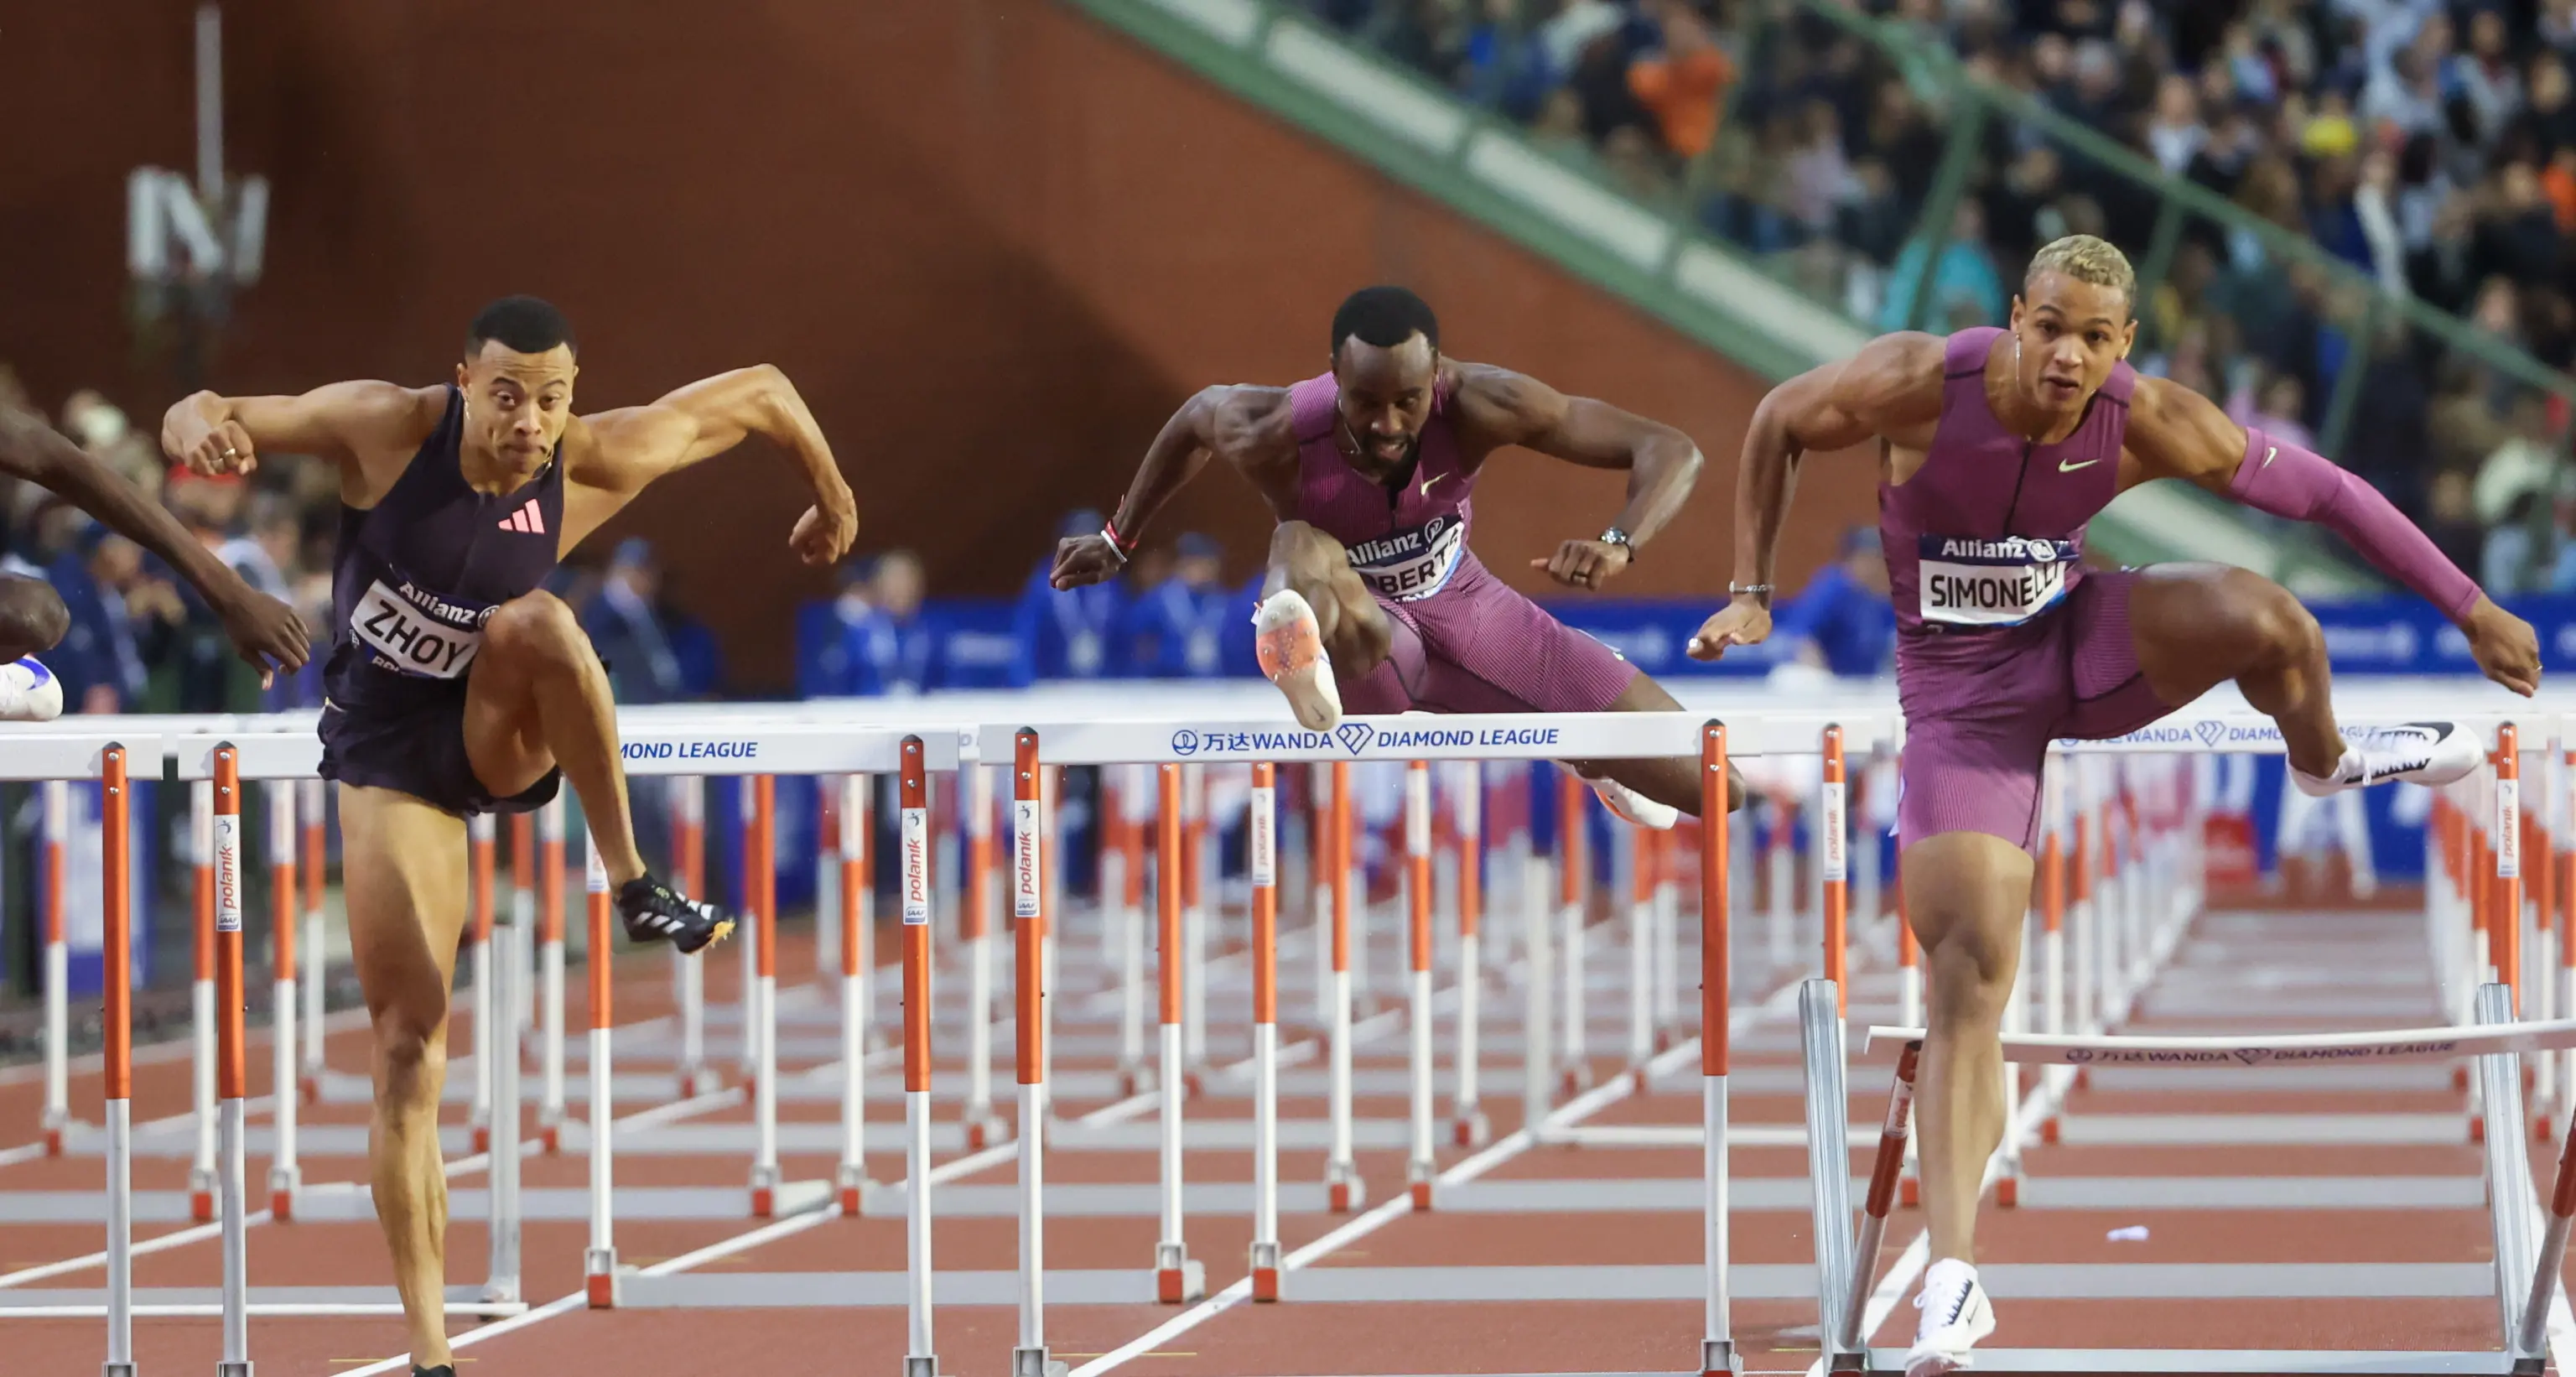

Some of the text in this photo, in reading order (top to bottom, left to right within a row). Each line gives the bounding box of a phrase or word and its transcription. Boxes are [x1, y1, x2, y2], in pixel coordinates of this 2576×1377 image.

[1346, 531, 1422, 565] Allianz
[1941, 538, 2027, 559] Allianz
[398, 581, 477, 625] Allianz
[1930, 563, 2059, 608] SIMONELLI
[678, 742, 758, 758] LEAGUE
[1377, 730, 1474, 747] DIAMOND
[1479, 729, 1560, 746] LEAGUE
[218, 844, 238, 910] polanik
[906, 837, 924, 902] polanik
[1018, 830, 1035, 896] polanik
[2273, 1047, 2371, 1060] DIAMOND
[2375, 1041, 2459, 1056] LEAGUE
